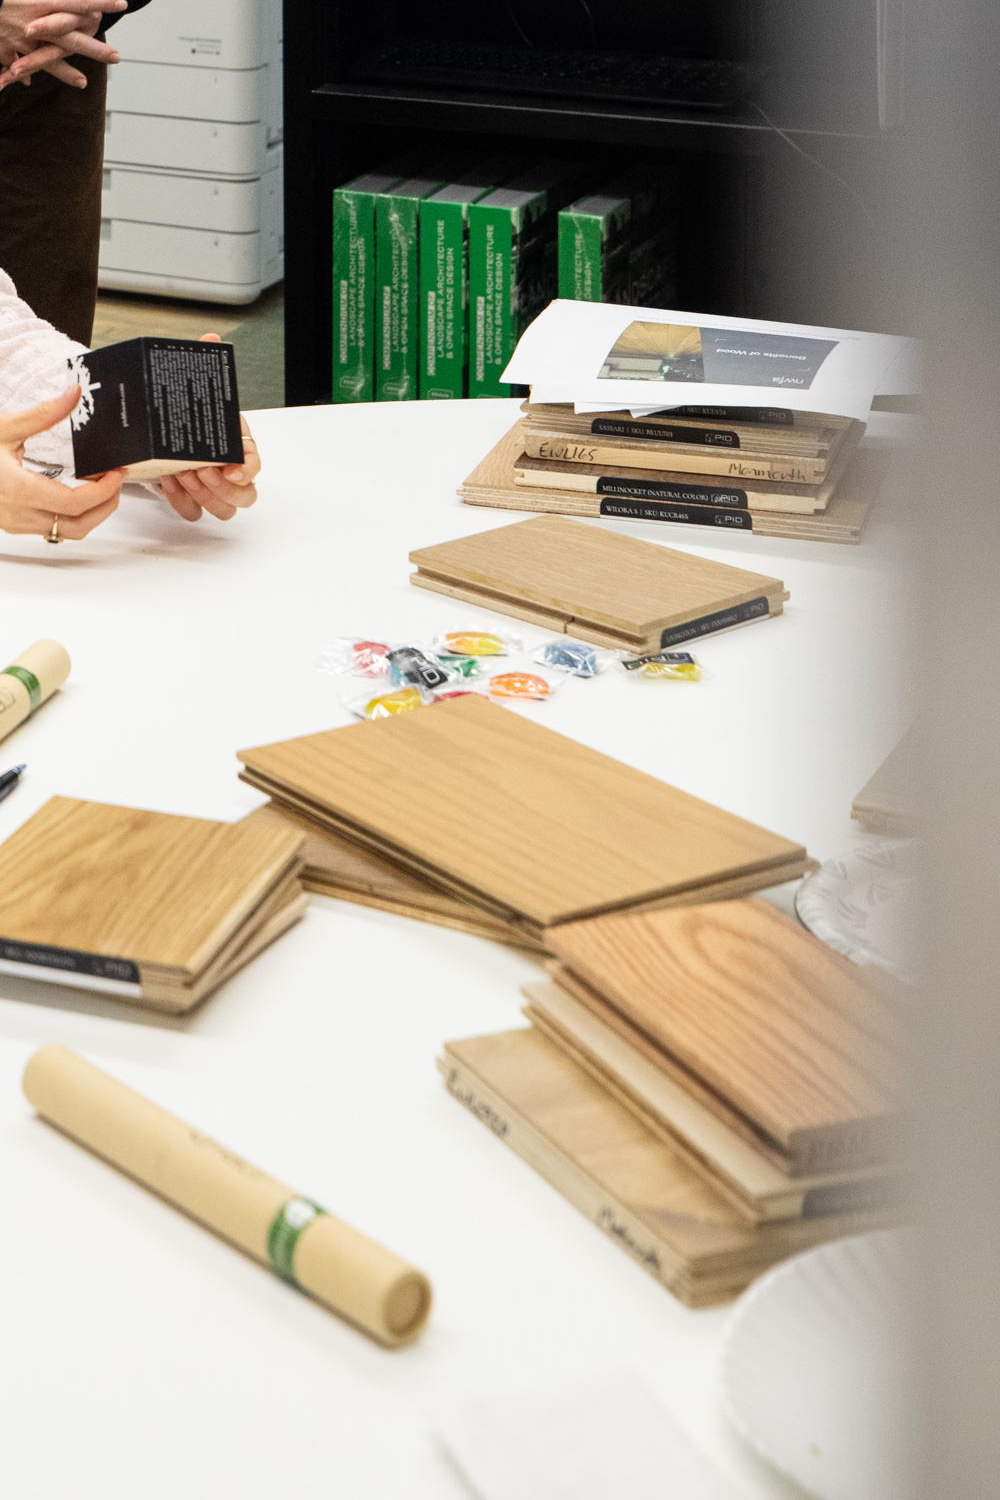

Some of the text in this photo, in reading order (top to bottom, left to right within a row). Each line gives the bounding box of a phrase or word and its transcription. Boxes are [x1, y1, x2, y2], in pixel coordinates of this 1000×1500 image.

[446, 247, 454, 285] DESIGN
[494, 253, 503, 290] DESIGN
[357, 276, 365, 308] SPACE
[436, 220, 445, 358] LANDSCAPE ARCHITECTURE
[485, 225, 494, 363] LANDSCAPE ARCHITECTURE
[583, 261, 592, 300] DESIGN
[400, 283, 408, 315] SPACE
[446, 288, 454, 319] SPACE
[494, 293, 503, 325] SPACE
[348, 286, 358, 346] LANDSCAPE
[357, 312, 365, 339] OPEN
[391, 293, 400, 352] LANDSCAPE
[400, 317, 408, 344] OPEN
[446, 322, 454, 349] OPEN
[494, 328, 503, 355] OPEN
[715, 348, 747, 356] Wood
[763, 352, 807, 361] Benefits
[772, 376, 805, 385] nwfa
[768, 411, 787, 420] PID
[598, 424, 625, 434] SASSARI
[631, 427, 645, 436] SKU:
[714, 434, 733, 443] PID
[728, 463, 807, 482] Monmouth
[602, 485, 647, 496] MILLINOCKET
[648, 489, 682, 499] (NATURAL
[682, 492, 709, 501] COLOR)
[720, 494, 739, 503] PID
[606, 505, 633, 514] WILORA
[645, 509, 659, 517] SKU:
[724, 515, 744, 524] PID
[410, 655, 441, 685] PID
